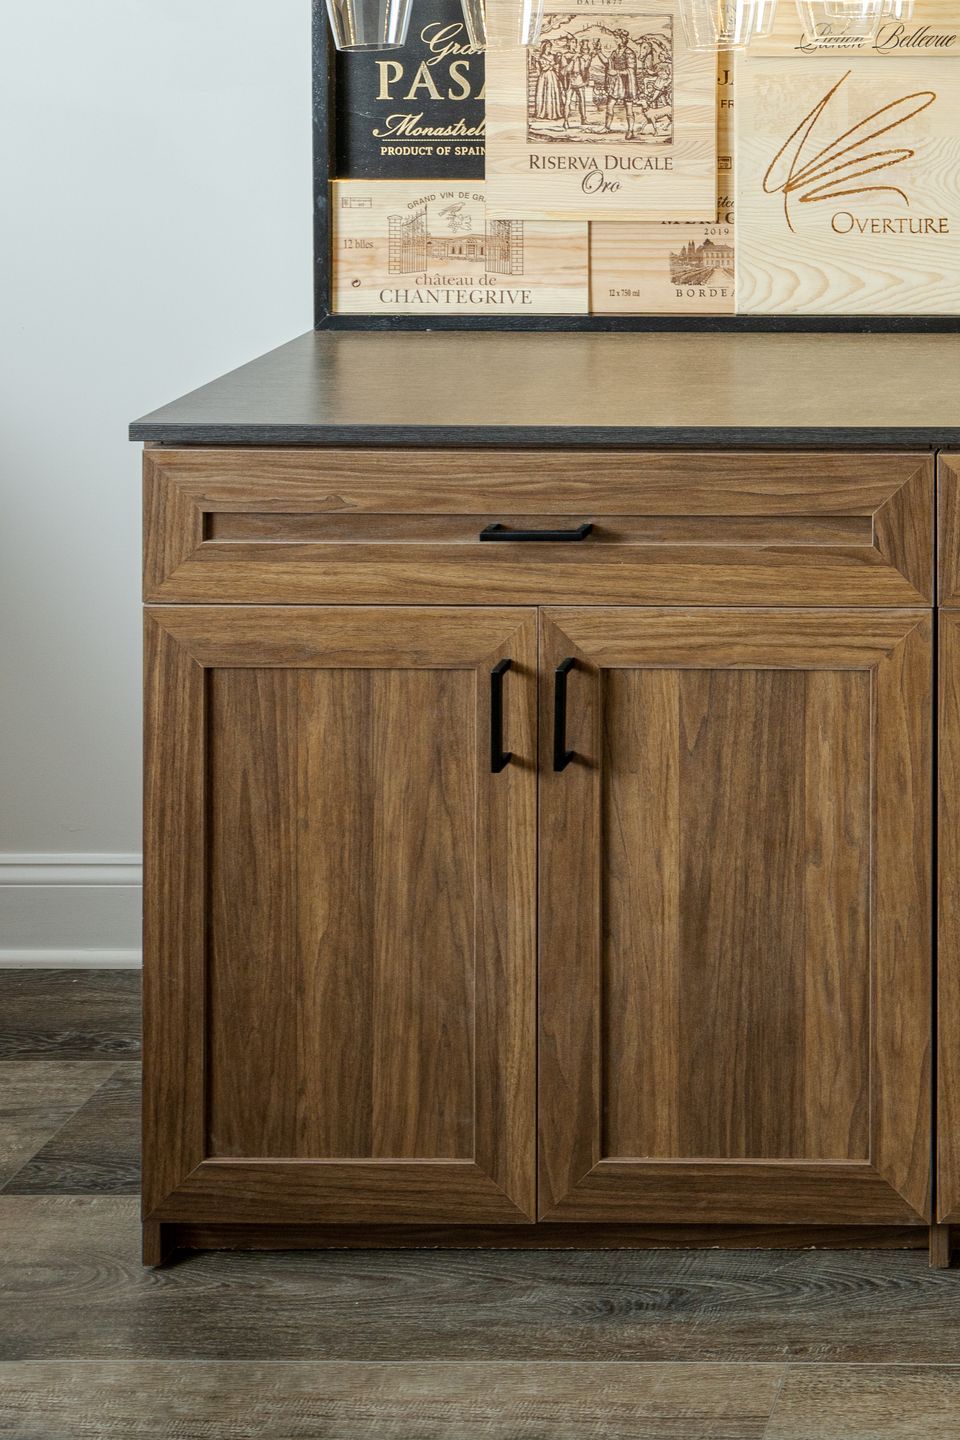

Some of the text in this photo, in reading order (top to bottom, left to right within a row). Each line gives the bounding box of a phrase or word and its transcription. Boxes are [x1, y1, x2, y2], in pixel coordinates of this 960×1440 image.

[872, 21, 957, 55] Bellevue
[380, 146, 433, 156] PRODUCT
[436, 146, 451, 156] OF
[529, 154, 673, 171] RISERVA DUCALE
[581, 169, 623, 195] Oro
[407, 194, 437, 211] GRAND
[440, 191, 455, 200] VIN
[458, 191, 471, 201] DE
[831, 211, 950, 235] OVERTURE
[704, 227, 730, 236] 2019
[343, 239, 353, 250] 12
[415, 273, 497, 287] château de
[379, 288, 533, 304] CHANTEGRIVE
